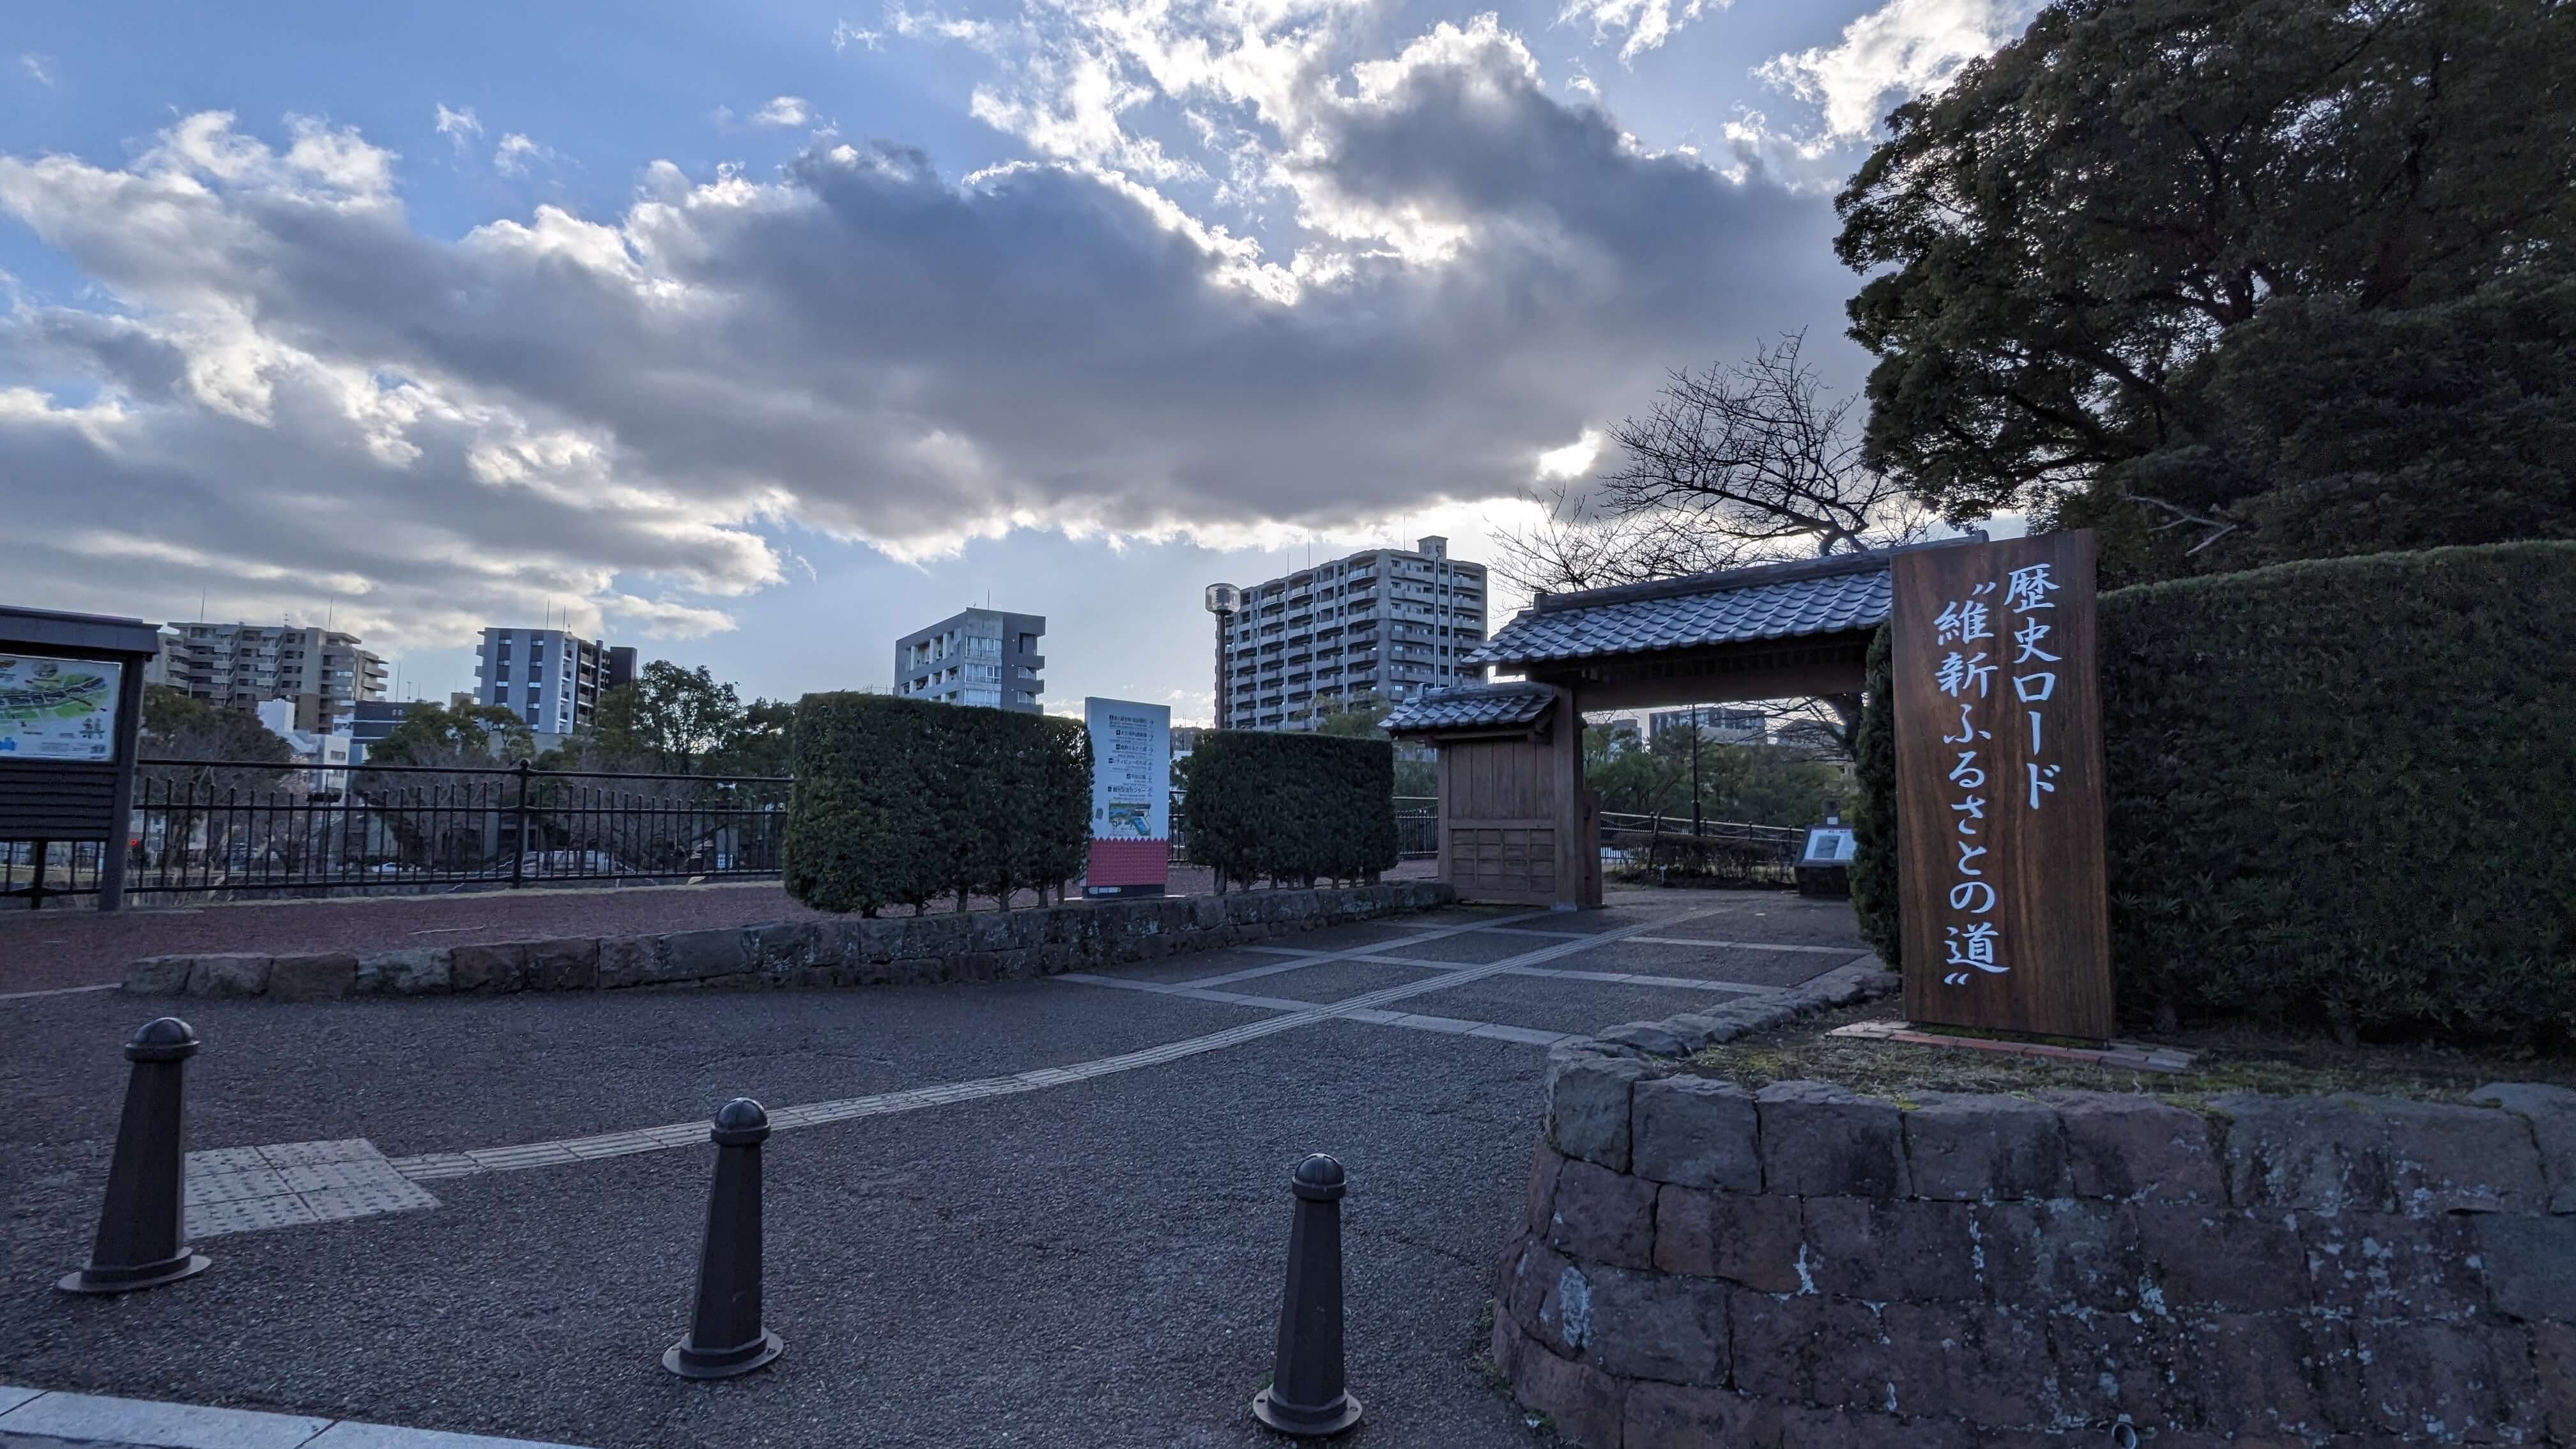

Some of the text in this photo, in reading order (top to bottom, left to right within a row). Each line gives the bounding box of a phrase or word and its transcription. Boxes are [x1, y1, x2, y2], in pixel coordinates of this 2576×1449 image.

[2004, 564, 2062, 809] 歴史ロード
